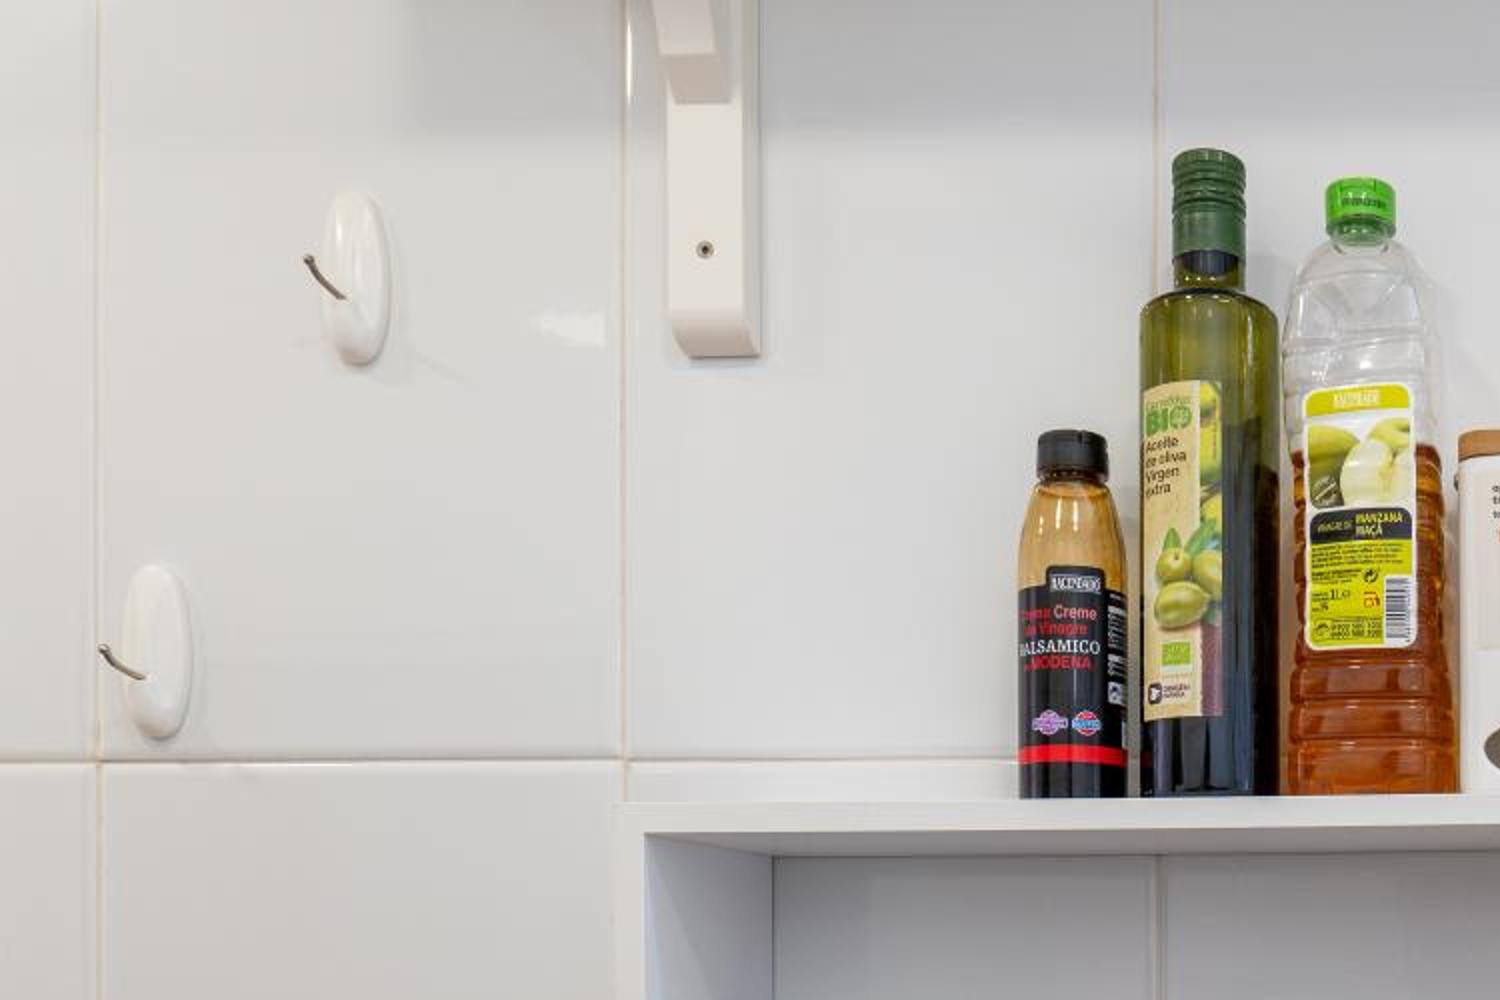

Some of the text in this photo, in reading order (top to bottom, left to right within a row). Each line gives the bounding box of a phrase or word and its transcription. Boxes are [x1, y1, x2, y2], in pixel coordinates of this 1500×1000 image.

[1146, 436, 1180, 453] Aceite
[1160, 451, 1187, 464] oliva
[1146, 466, 1181, 483] Virgen
